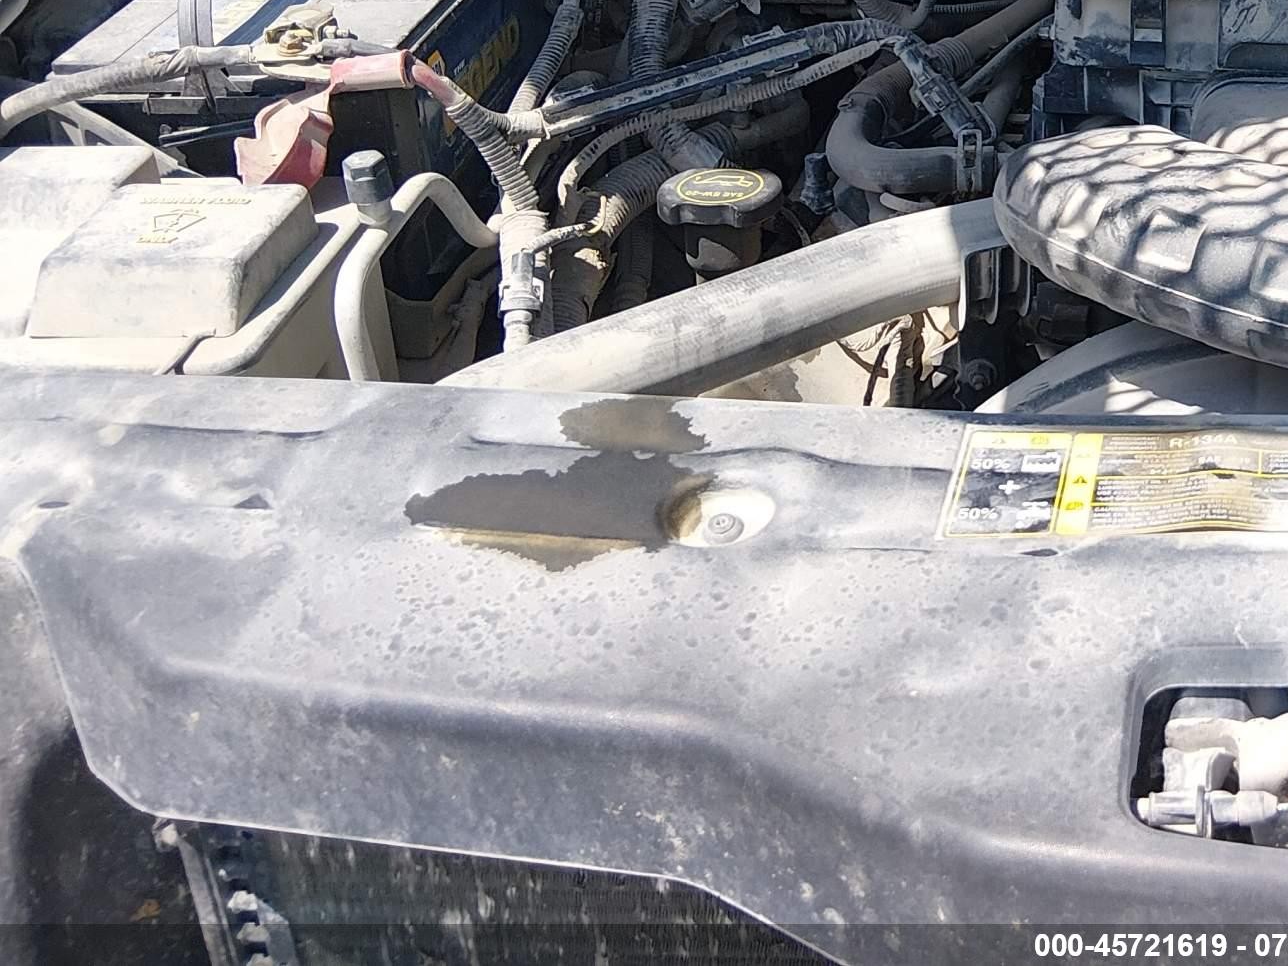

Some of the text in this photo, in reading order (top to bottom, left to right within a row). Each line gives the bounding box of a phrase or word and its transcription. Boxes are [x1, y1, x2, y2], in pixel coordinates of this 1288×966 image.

[1168, 434, 1239, 449] R-134A
[971, 458, 1012, 470] 50%
[957, 507, 999, 520] 50%
